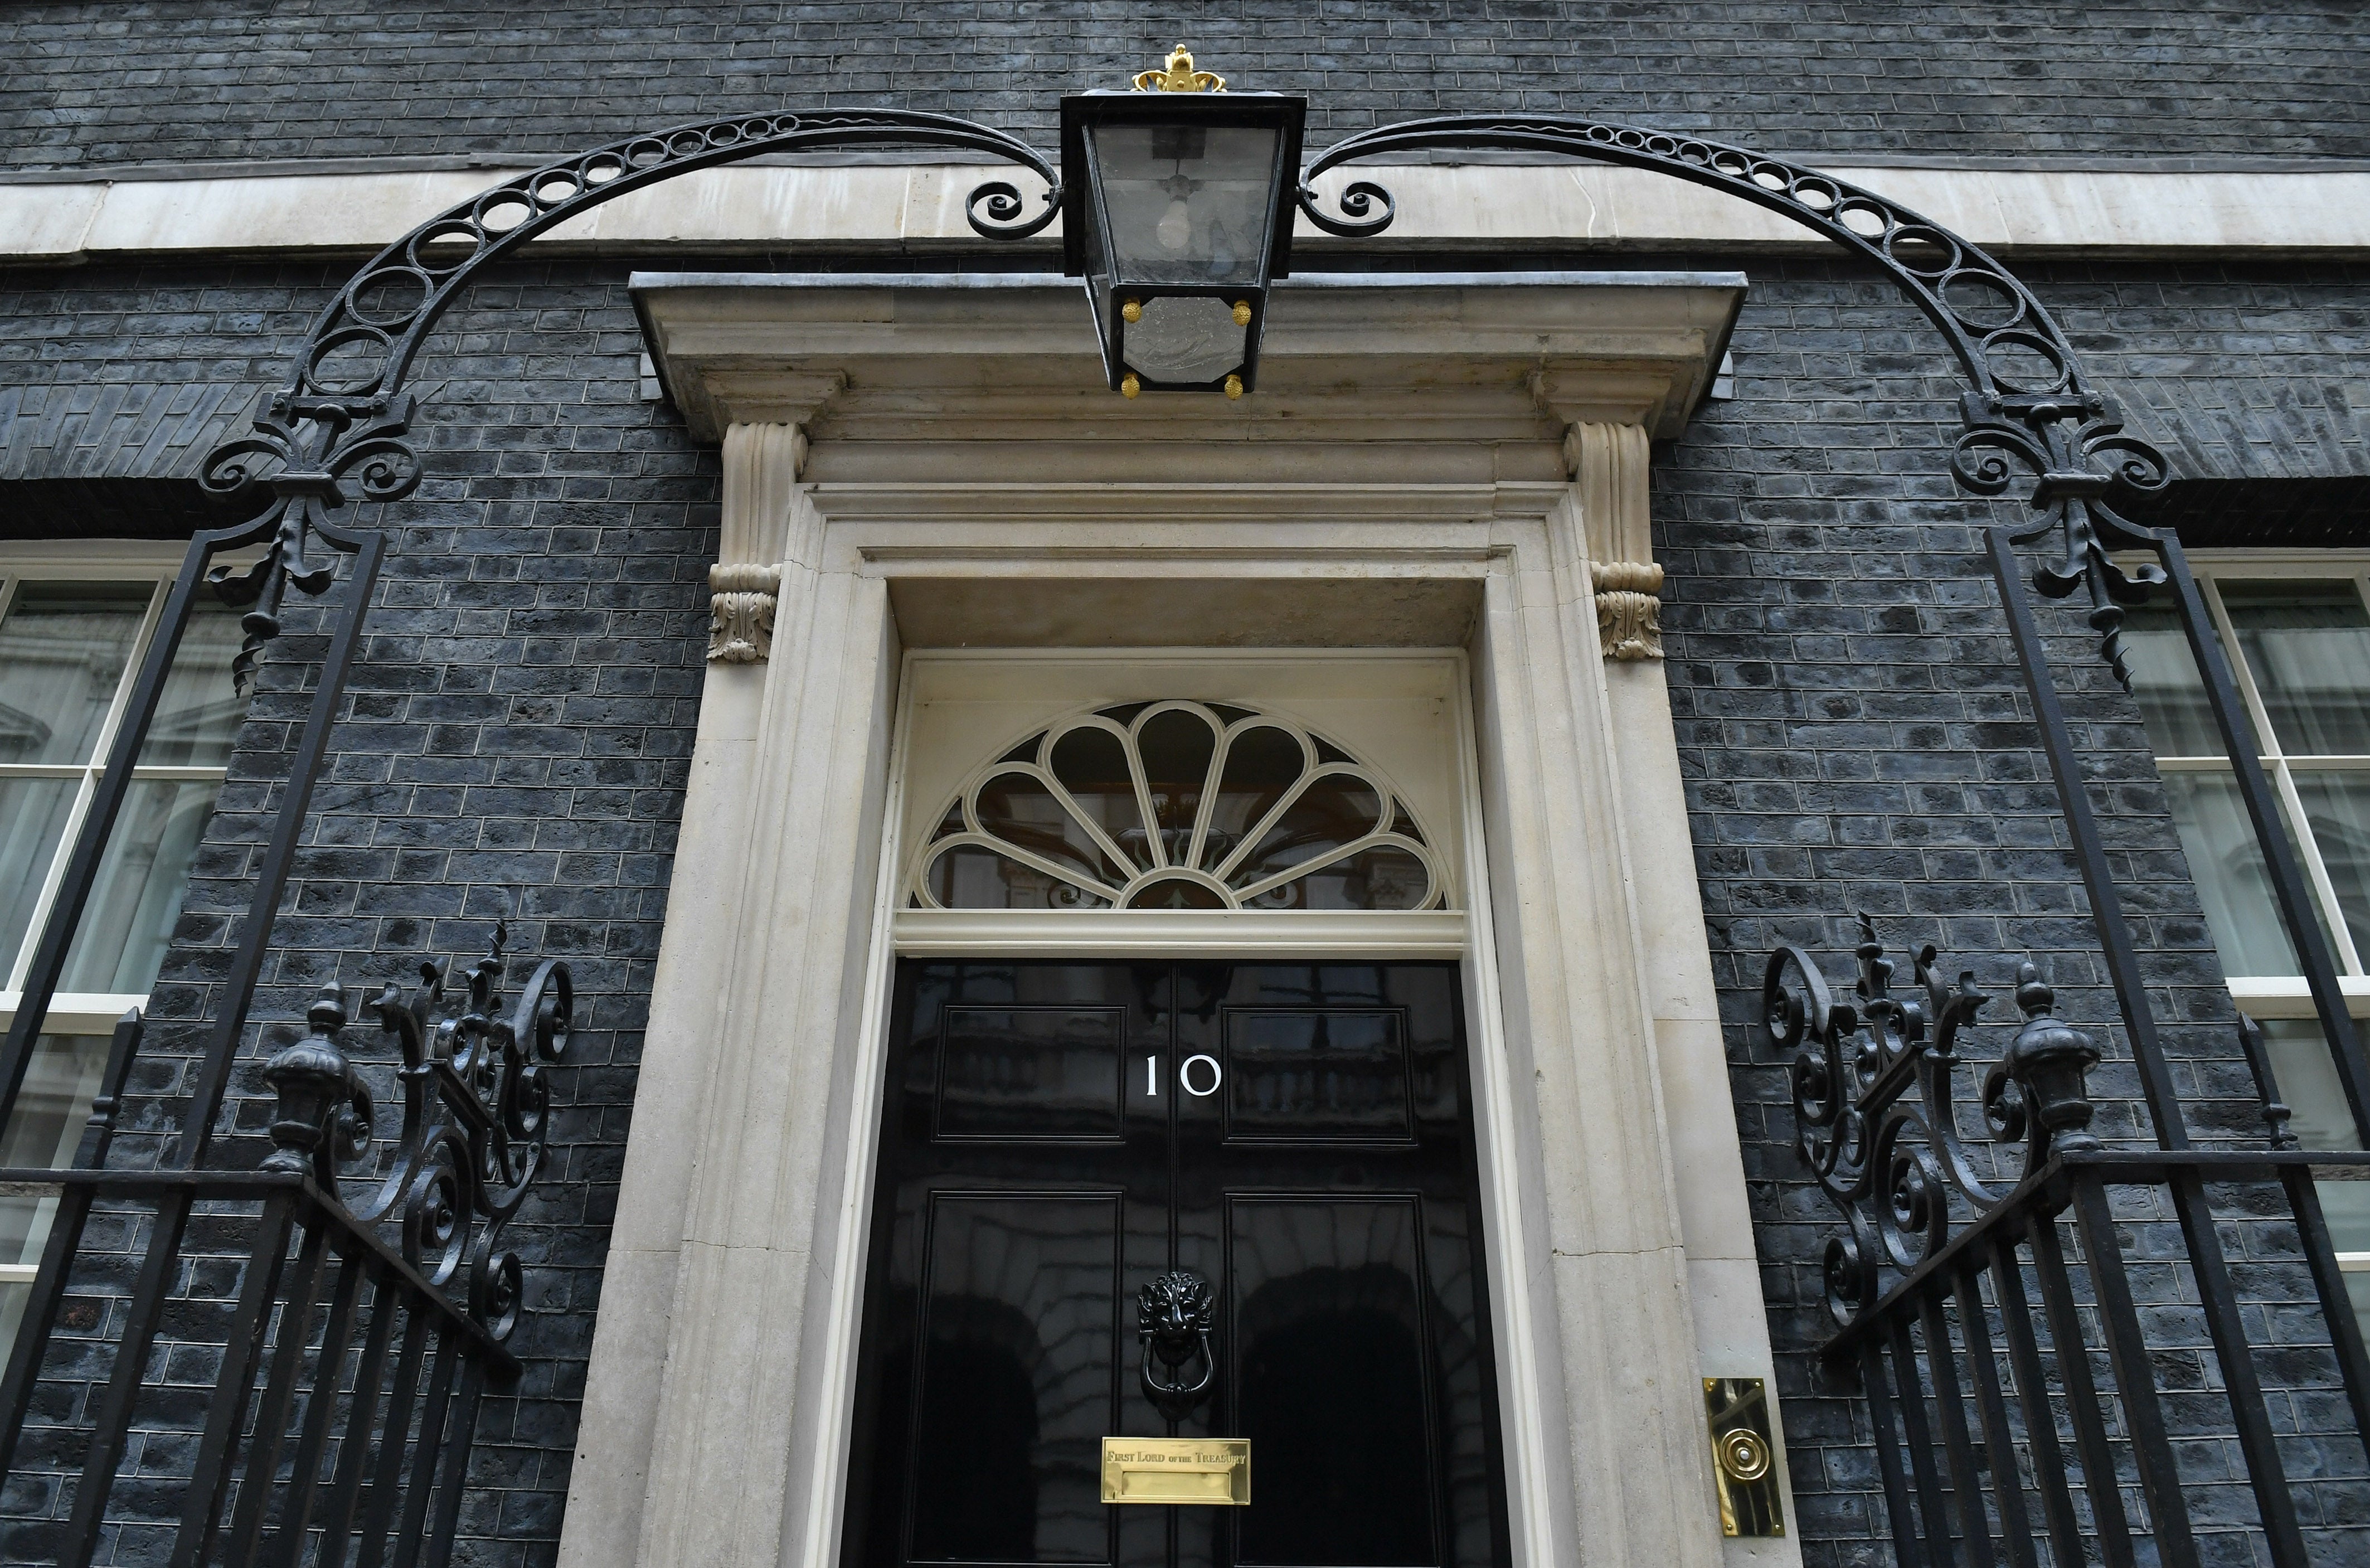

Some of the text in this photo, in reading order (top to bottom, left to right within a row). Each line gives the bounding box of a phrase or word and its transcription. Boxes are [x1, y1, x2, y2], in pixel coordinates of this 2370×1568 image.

[1147, 1055, 1221, 1096] 10
[1107, 1451, 1134, 1463] FIRST
[1138, 1452, 1165, 1463] LORD
[1196, 1452, 1246, 1464] TREASURY
